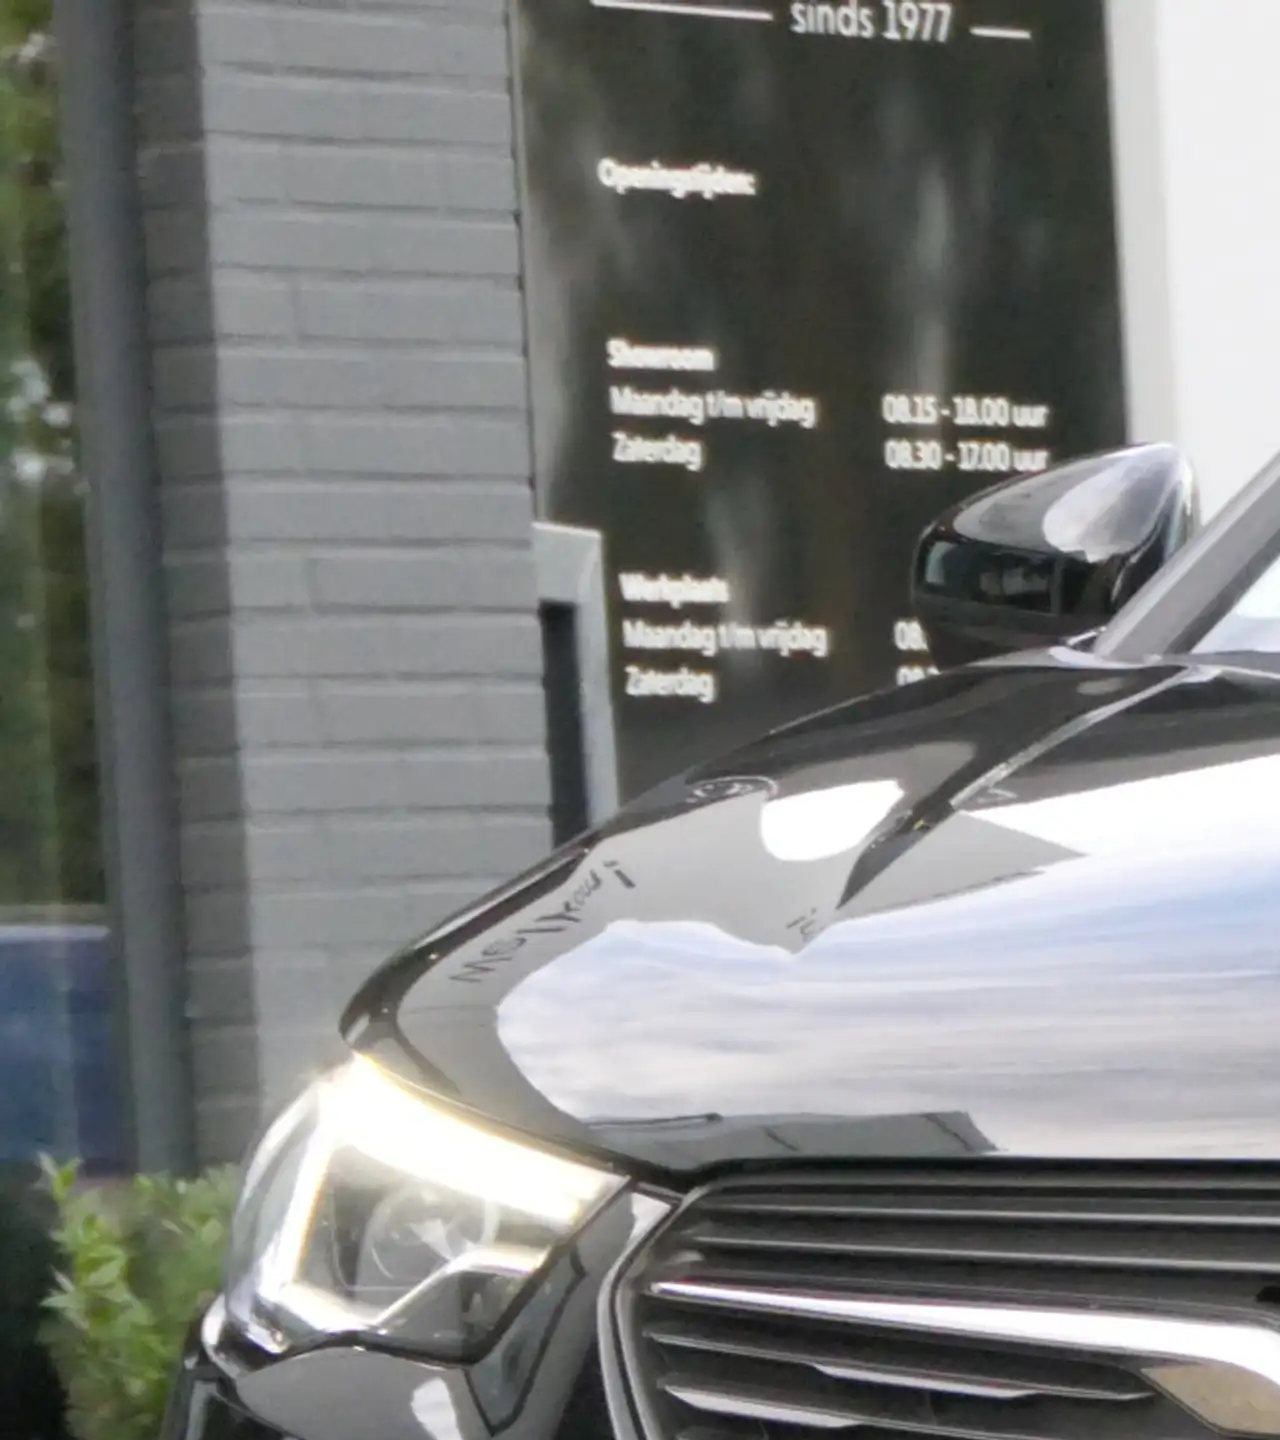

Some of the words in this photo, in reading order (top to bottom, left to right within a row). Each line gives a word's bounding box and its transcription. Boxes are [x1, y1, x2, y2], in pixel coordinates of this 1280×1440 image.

[790, 0, 874, 39] sinds
[881, 0, 952, 42] 1977
[609, 385, 705, 426] Maandag
[706, 389, 743, 419] t/m
[744, 389, 817, 429] vrijdag
[1012, 405, 1049, 427] uur
[611, 430, 704, 472] Zaterdag
[885, 438, 942, 471] 08.30
[957, 441, 1010, 472] 17.00
[1013, 450, 1049, 472] uur
[622, 618, 716, 657] Maandag
[756, 616, 829, 658] vrijdag
[624, 663, 715, 704] Zaterdag
